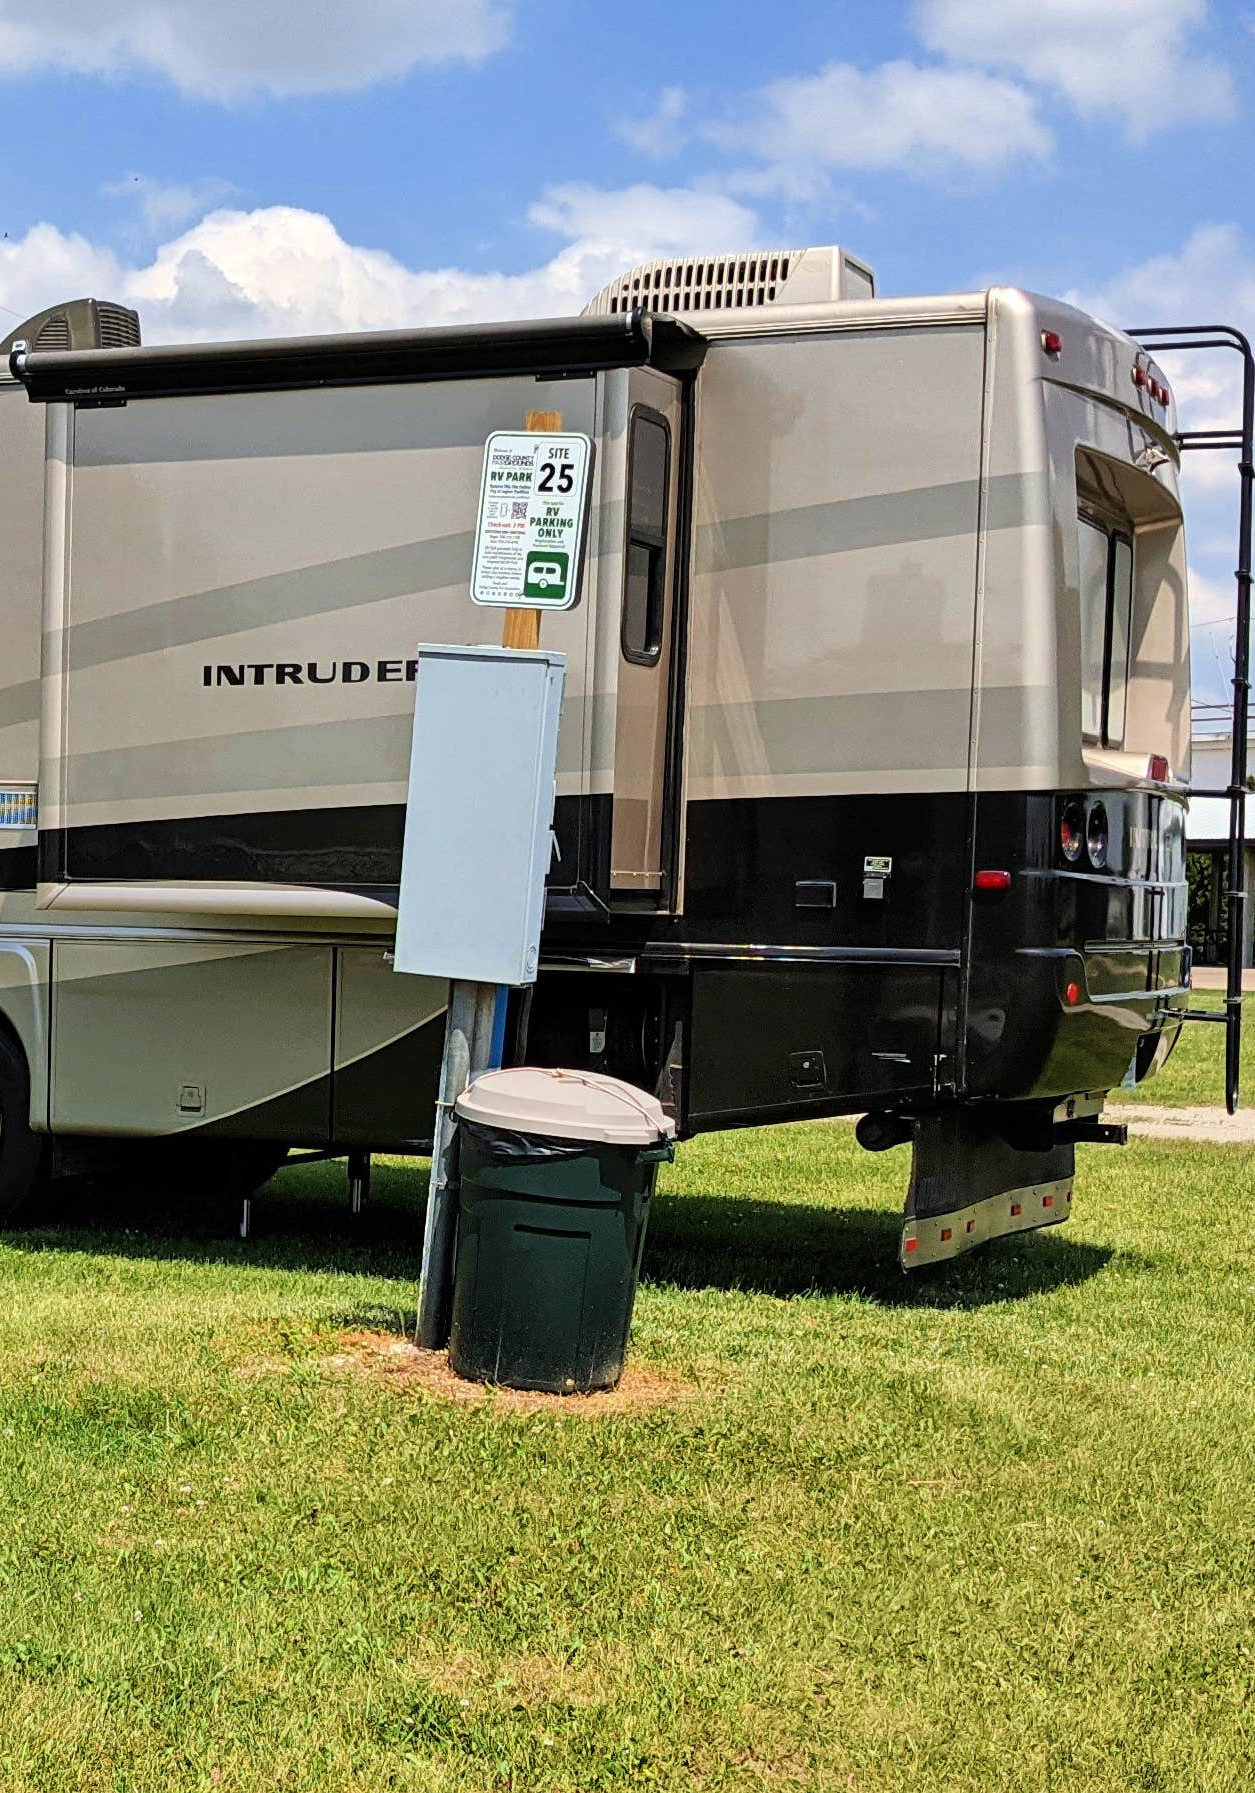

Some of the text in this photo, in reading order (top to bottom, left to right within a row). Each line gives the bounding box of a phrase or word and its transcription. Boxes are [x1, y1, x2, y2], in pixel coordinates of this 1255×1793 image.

[548, 447, 570, 460] SITE
[490, 471, 533, 482] RV PARK
[537, 462, 575, 494] 25
[545, 506, 560, 517] RV
[529, 516, 574, 528] PARKING
[537, 527, 564, 539] ONLY
